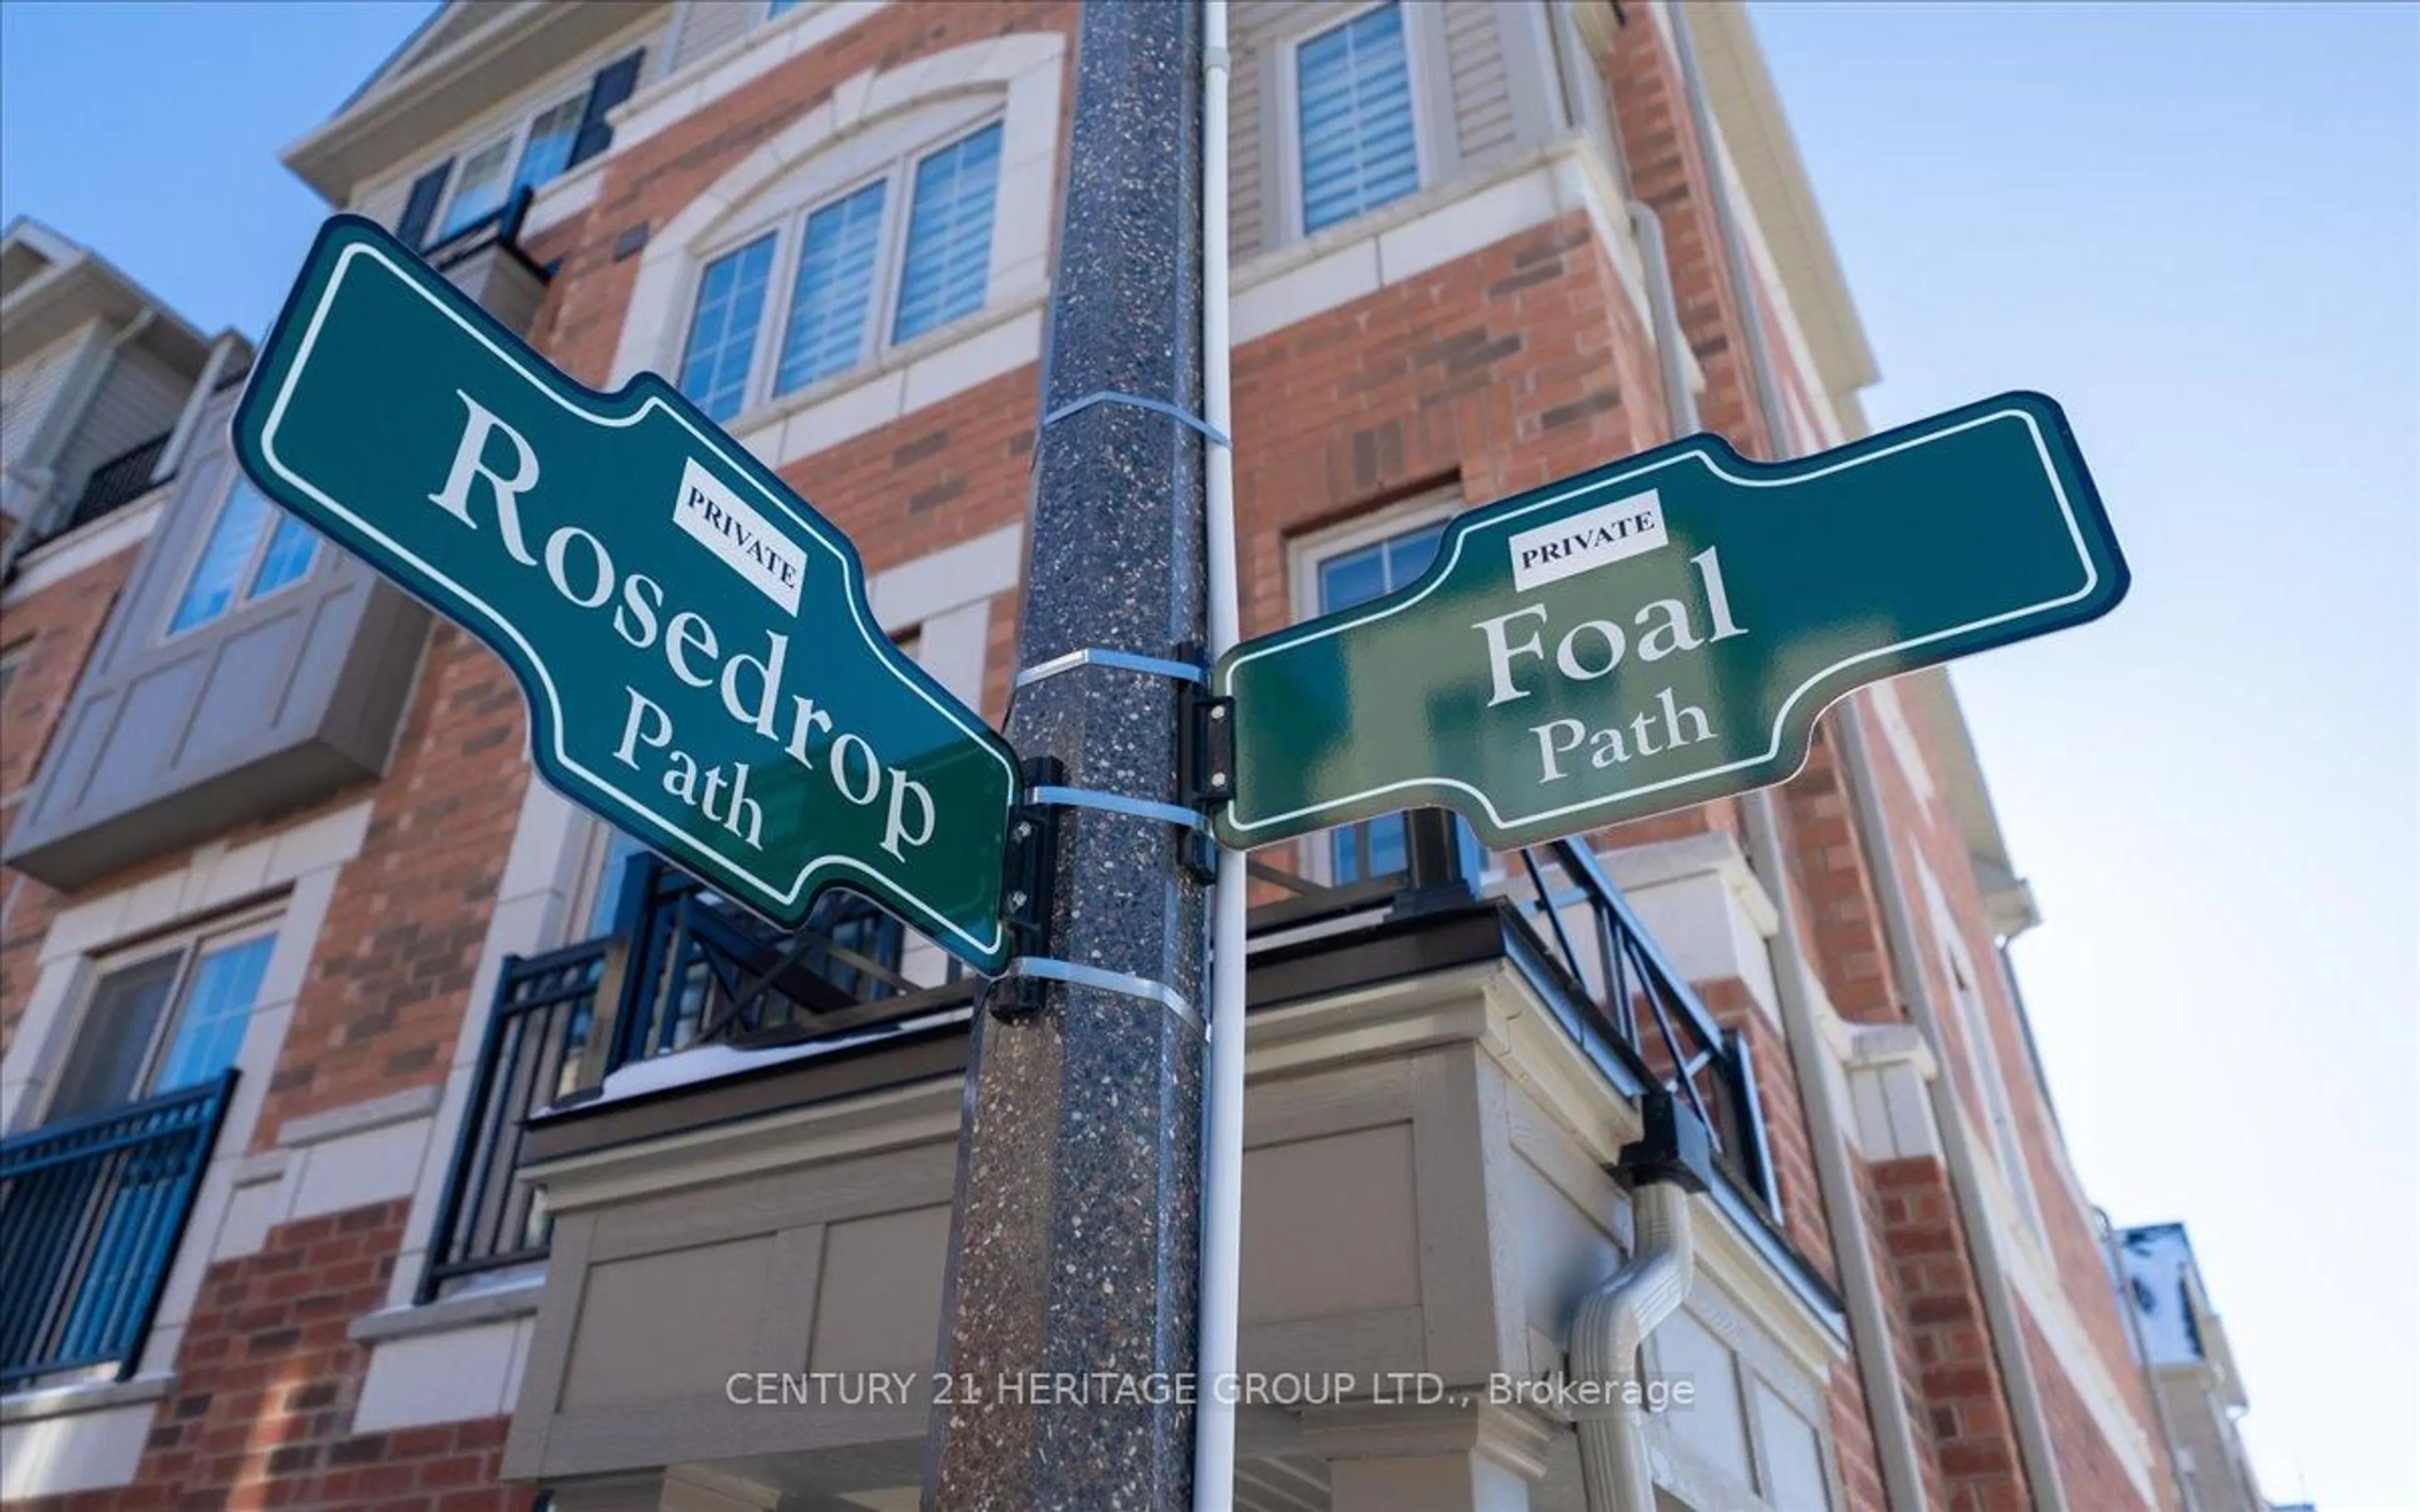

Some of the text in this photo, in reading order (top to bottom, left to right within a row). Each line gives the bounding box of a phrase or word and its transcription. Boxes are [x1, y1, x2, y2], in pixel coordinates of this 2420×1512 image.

[686, 484, 798, 590] PRIVATE
[1521, 512, 1656, 570] PRIVATE
[429, 389, 936, 861] Rosedrop
[1472, 547, 1749, 706] Foal
[614, 687, 763, 849] Path
[1530, 689, 1717, 782] Path
